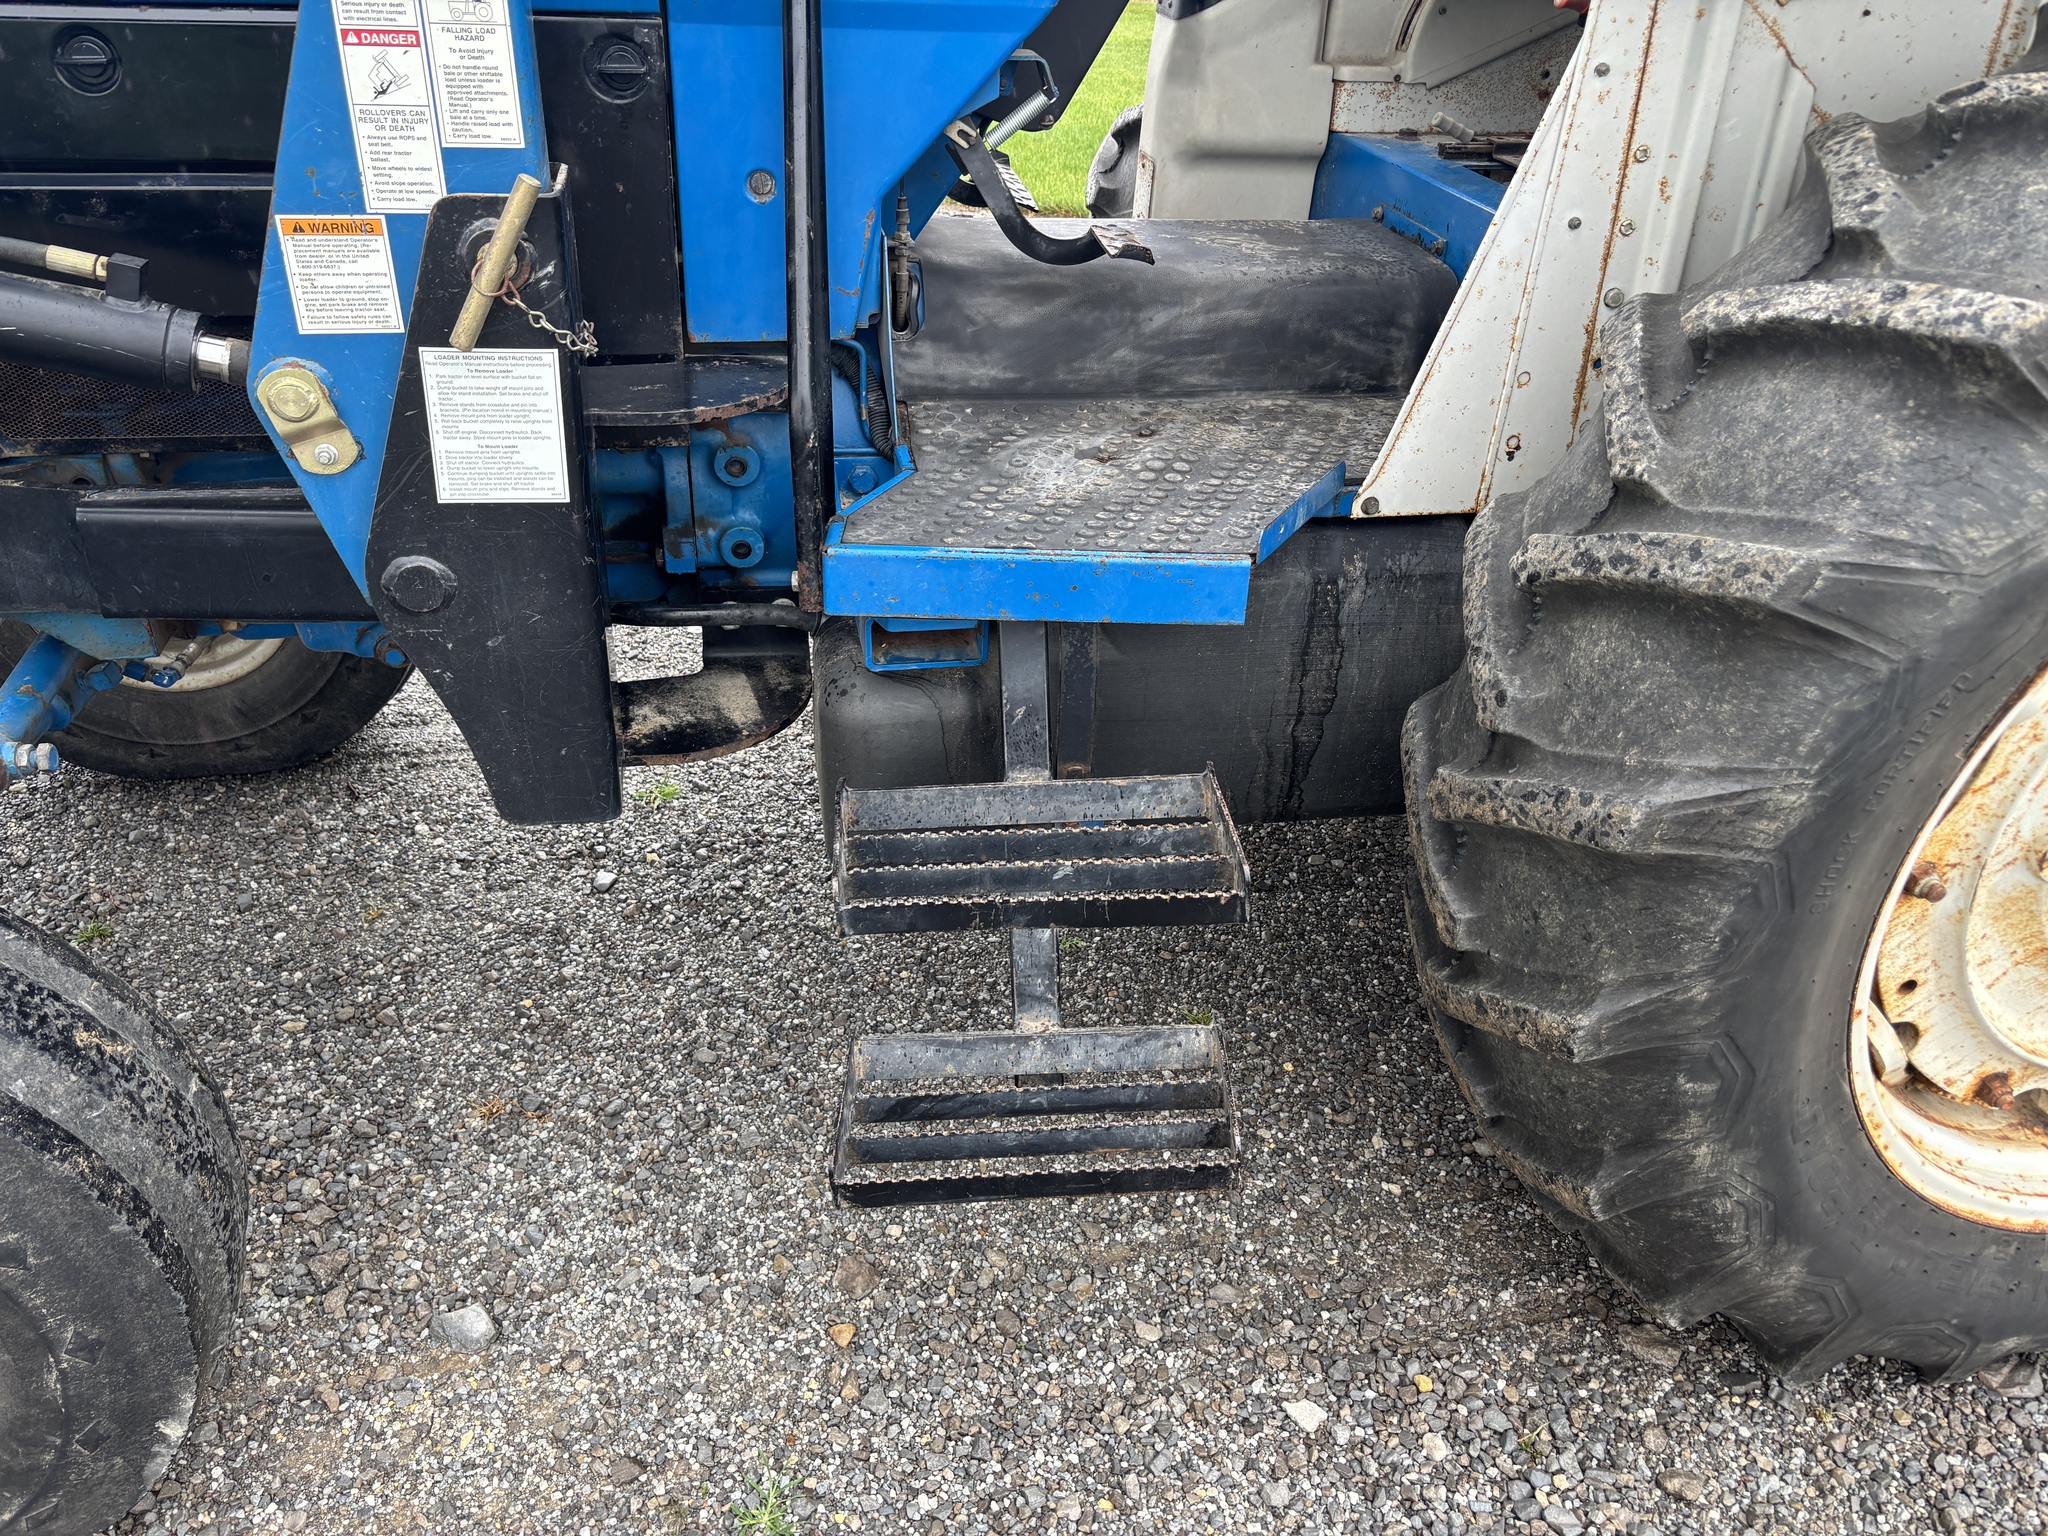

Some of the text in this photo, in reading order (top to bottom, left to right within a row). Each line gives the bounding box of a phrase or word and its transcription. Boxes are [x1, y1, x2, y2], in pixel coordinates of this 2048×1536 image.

[361, 33, 416, 45] DANGER
[308, 222, 374, 233] WARNING
[1860, 672, 1974, 812] FORTIFIED
